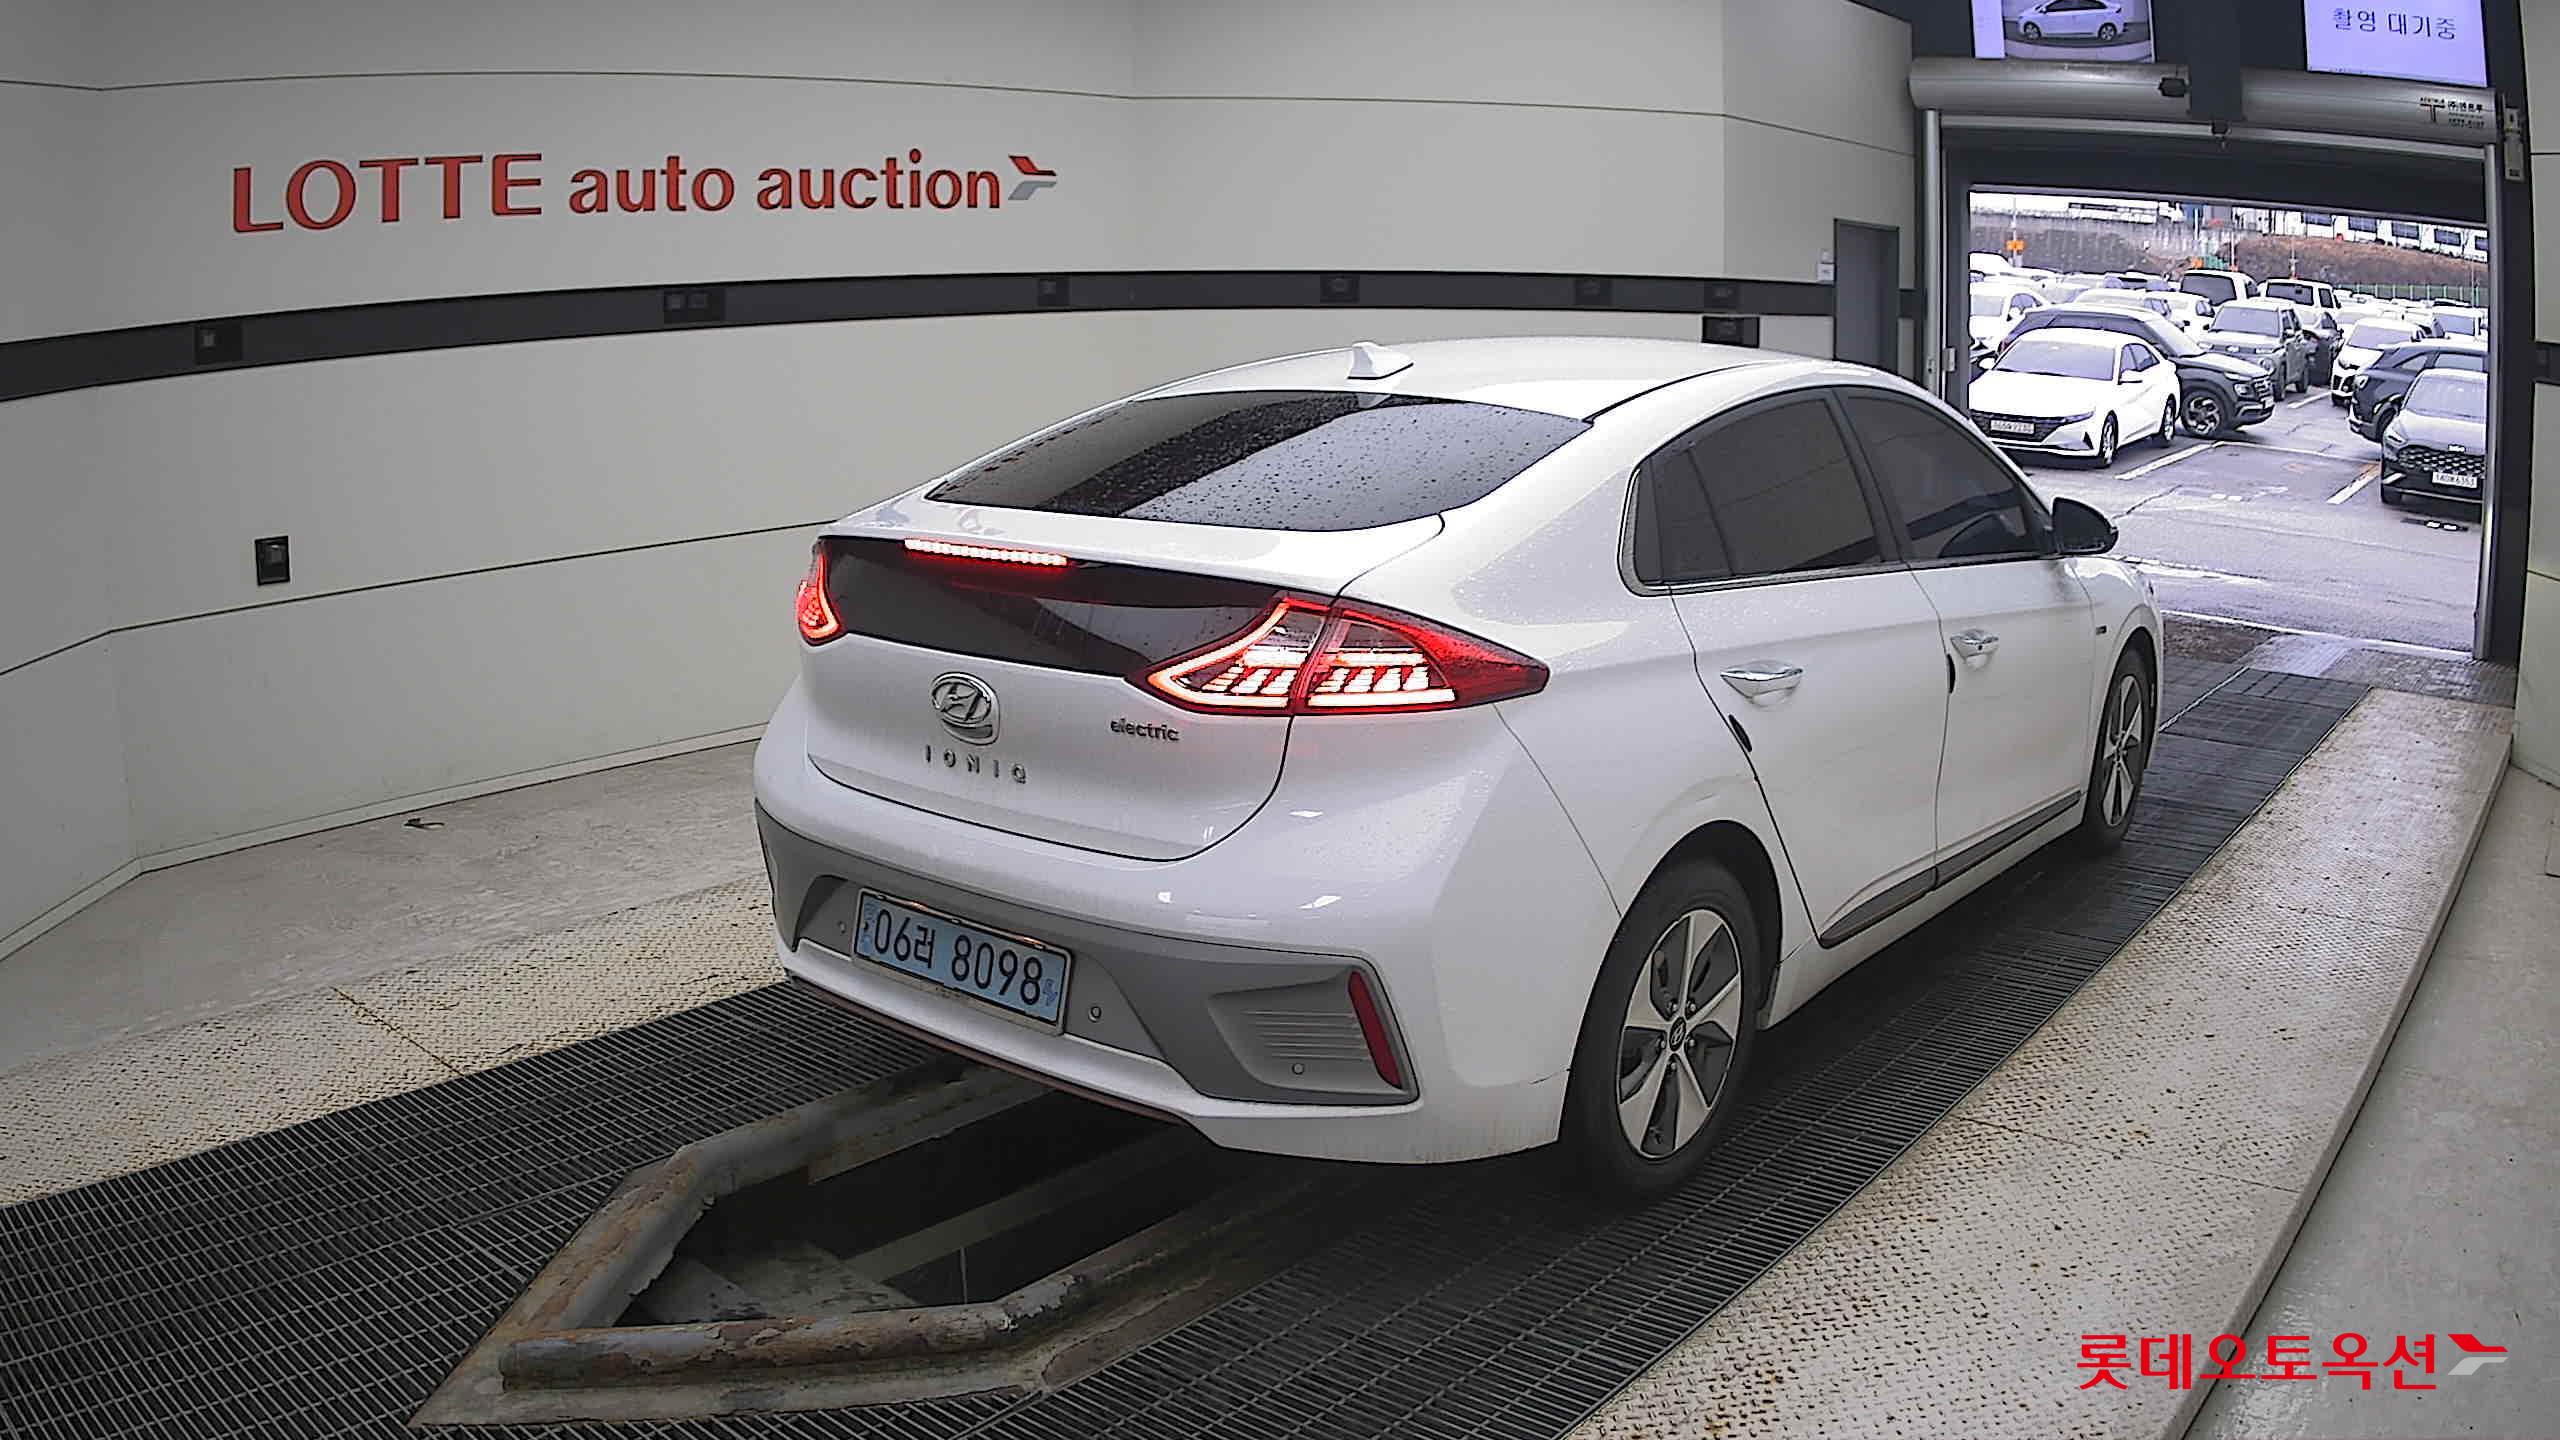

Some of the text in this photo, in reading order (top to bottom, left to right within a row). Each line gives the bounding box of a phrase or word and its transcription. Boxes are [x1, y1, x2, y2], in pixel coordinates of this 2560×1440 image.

[2387, 12, 2457, 40] 대기중
[233, 148, 1002, 233] LOTTE auto auction
[1110, 717, 1180, 742] electric
[925, 743, 1028, 784] IONIQ
[874, 909, 1043, 1006] 06러 8098
